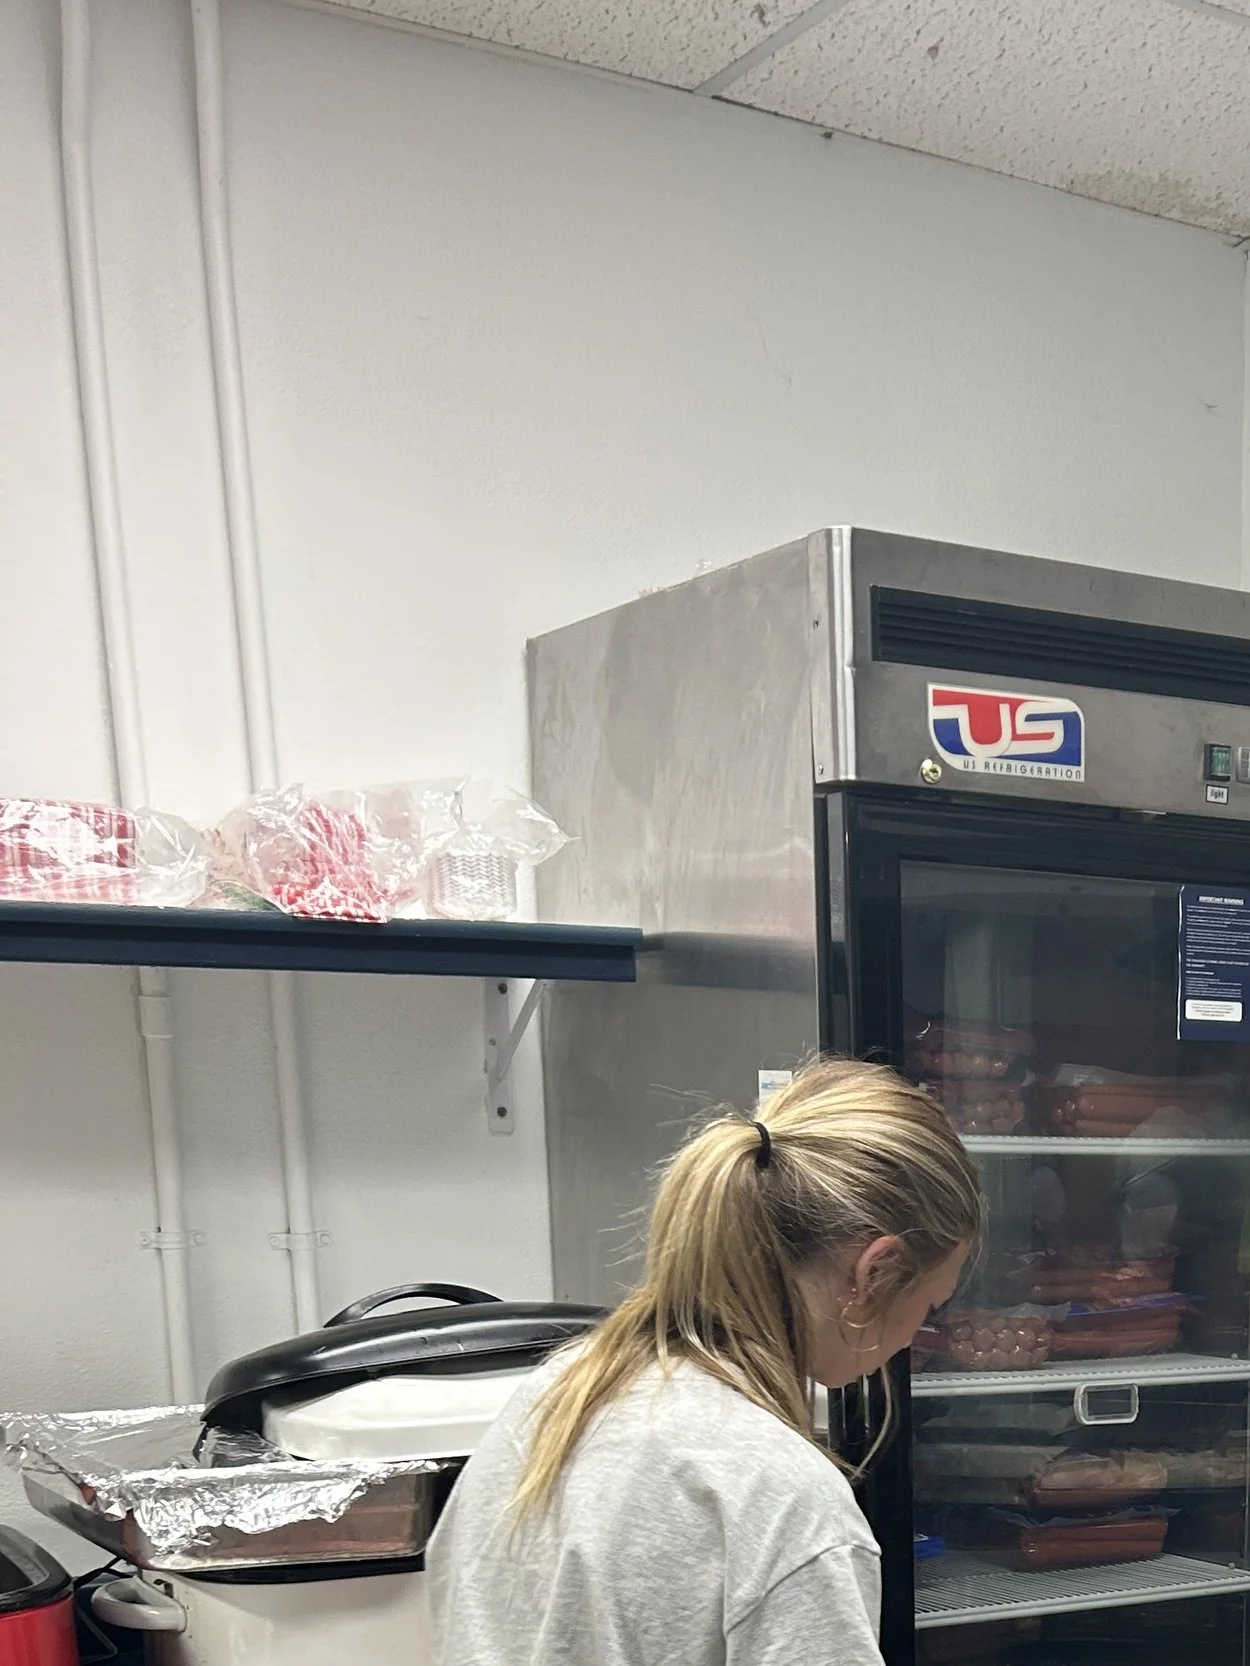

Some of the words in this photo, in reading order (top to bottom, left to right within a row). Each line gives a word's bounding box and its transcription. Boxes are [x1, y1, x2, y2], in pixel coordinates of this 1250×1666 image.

[933, 701, 1066, 757] US
[963, 760, 976, 770] US
[984, 762, 1081, 779] REFRIGERATION
